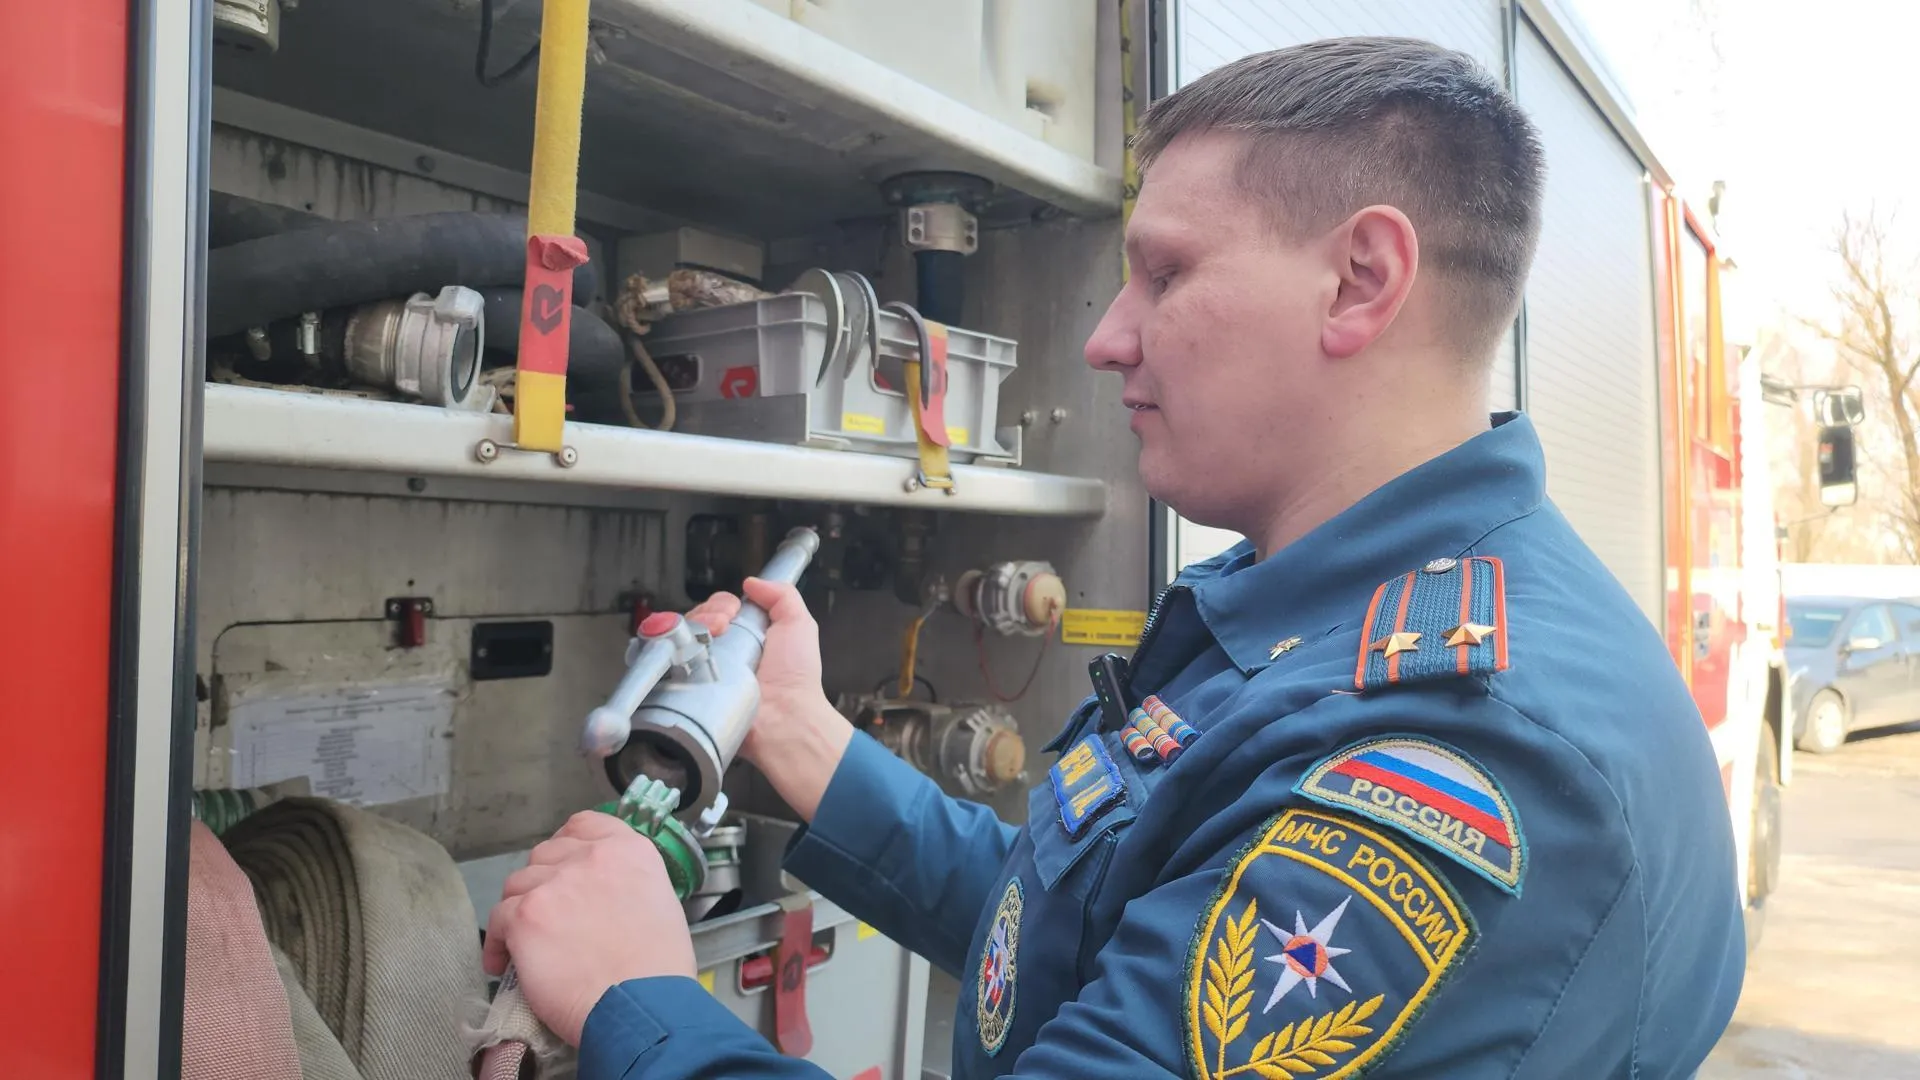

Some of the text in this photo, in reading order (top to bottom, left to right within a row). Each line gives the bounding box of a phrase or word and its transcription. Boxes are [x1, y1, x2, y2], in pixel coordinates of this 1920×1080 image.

[1350, 778, 1486, 855] РОССИЯ
[1277, 820, 1454, 958] МЧС РОССИИ
